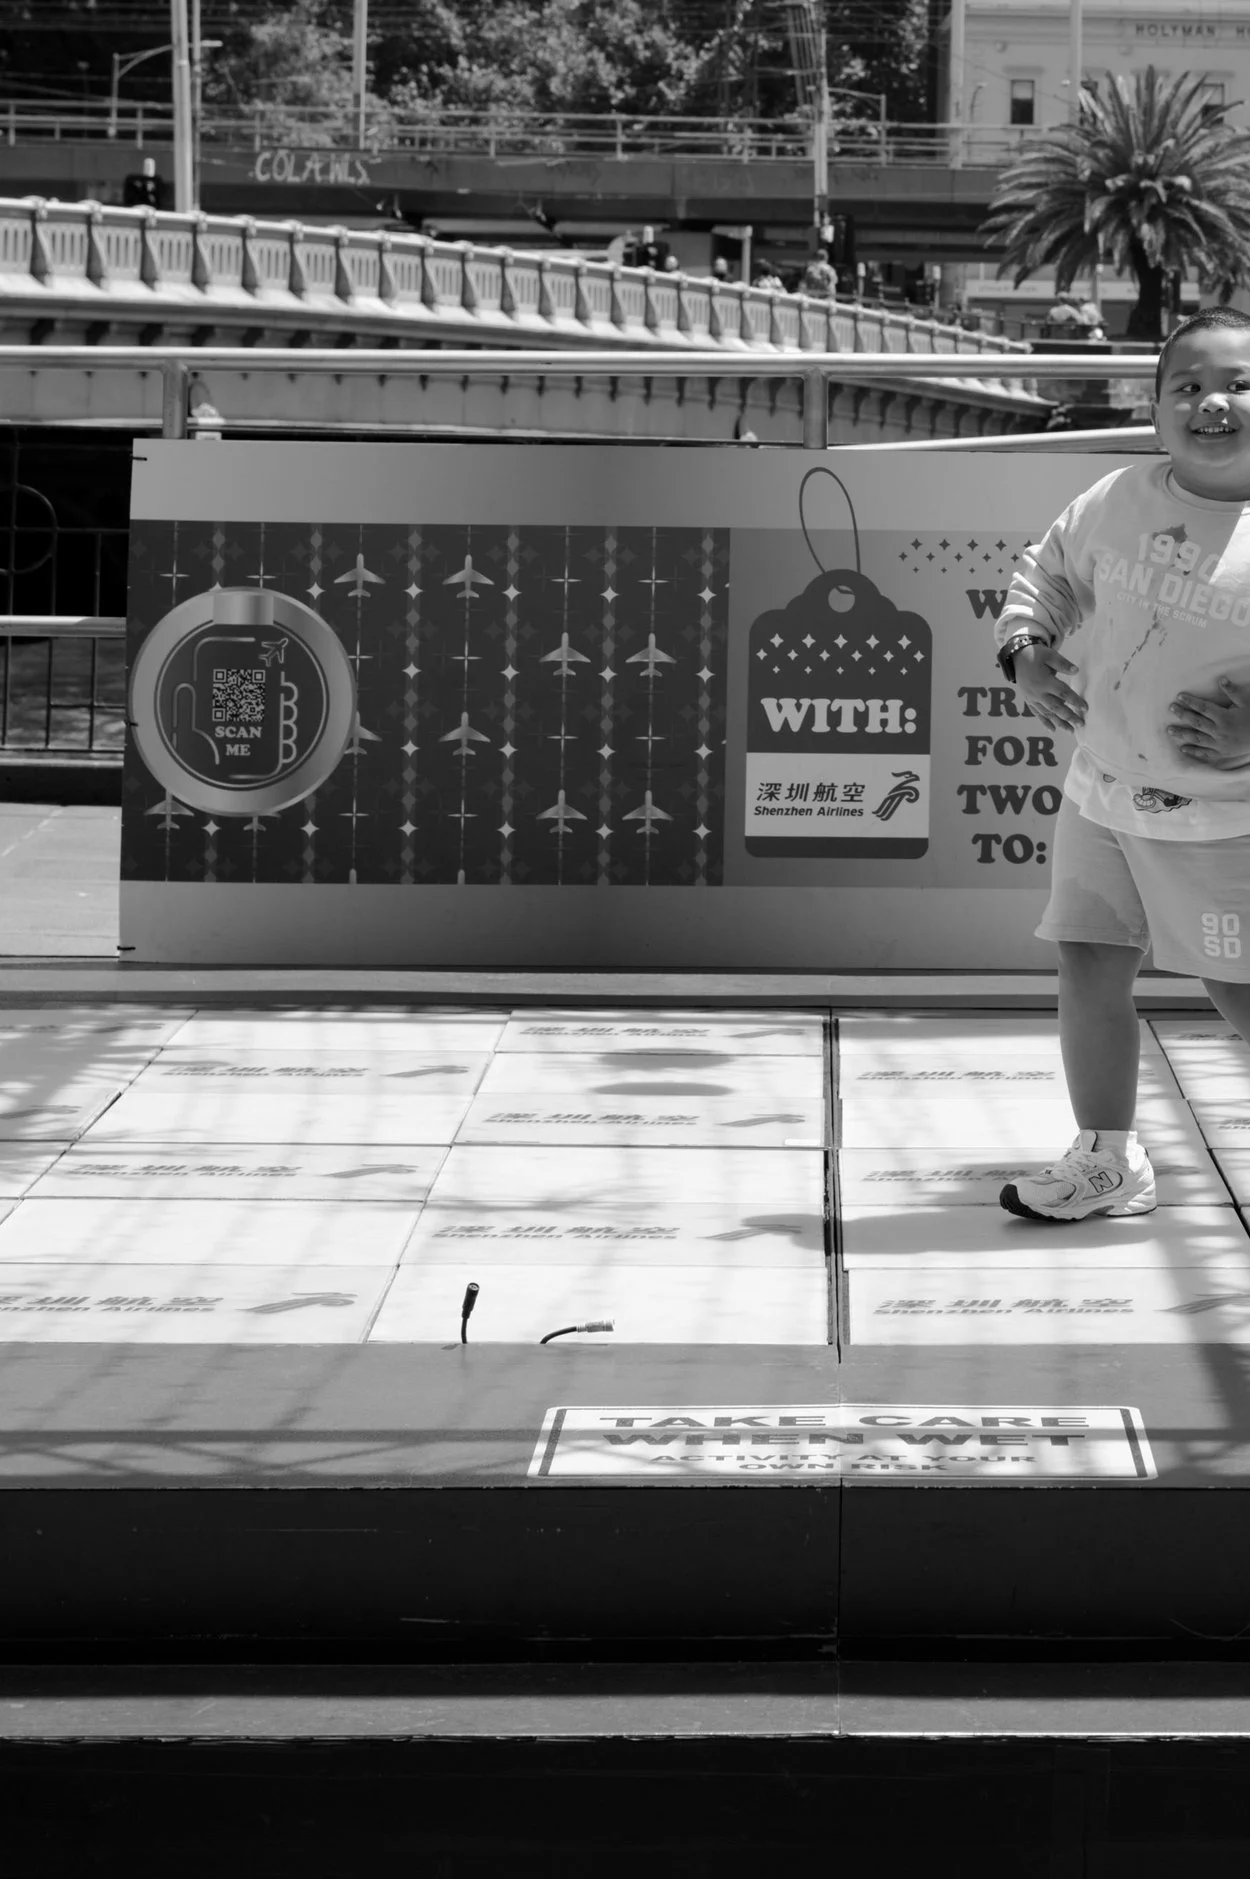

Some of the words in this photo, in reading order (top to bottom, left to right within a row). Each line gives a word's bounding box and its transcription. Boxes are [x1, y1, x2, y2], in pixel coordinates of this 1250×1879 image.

[1134, 22, 1216, 38] HOLYMAN
[1098, 552, 1154, 596] SAN
[760, 697, 918, 734] WITH:
[214, 725, 263, 739] SCAN
[225, 743, 251, 757] ME
[963, 735, 1059, 767] FOR
[756, 781, 866, 803] 深圳航空
[956, 783, 1064, 816] TWO
[753, 805, 813, 817] Shenzhen
[816, 806, 865, 817] Airlines
[971, 832, 1048, 865] TO:
[1200, 911, 1241, 937] 90
[1203, 935, 1242, 959] SD
[879, 1298, 1136, 1308] 深圳航空
[599, 1414, 827, 1429] TAKE
[858, 1414, 1091, 1429] CARE
[602, 1432, 865, 1447] WHEN
[896, 1433, 1086, 1447] WET
[650, 1453, 842, 1463] ACTIVITY
[856, 1453, 909, 1463] AT
[922, 1454, 1037, 1464] YOUR
[738, 1463, 836, 1472] OWN
[851, 1463, 951, 1472] RISK
